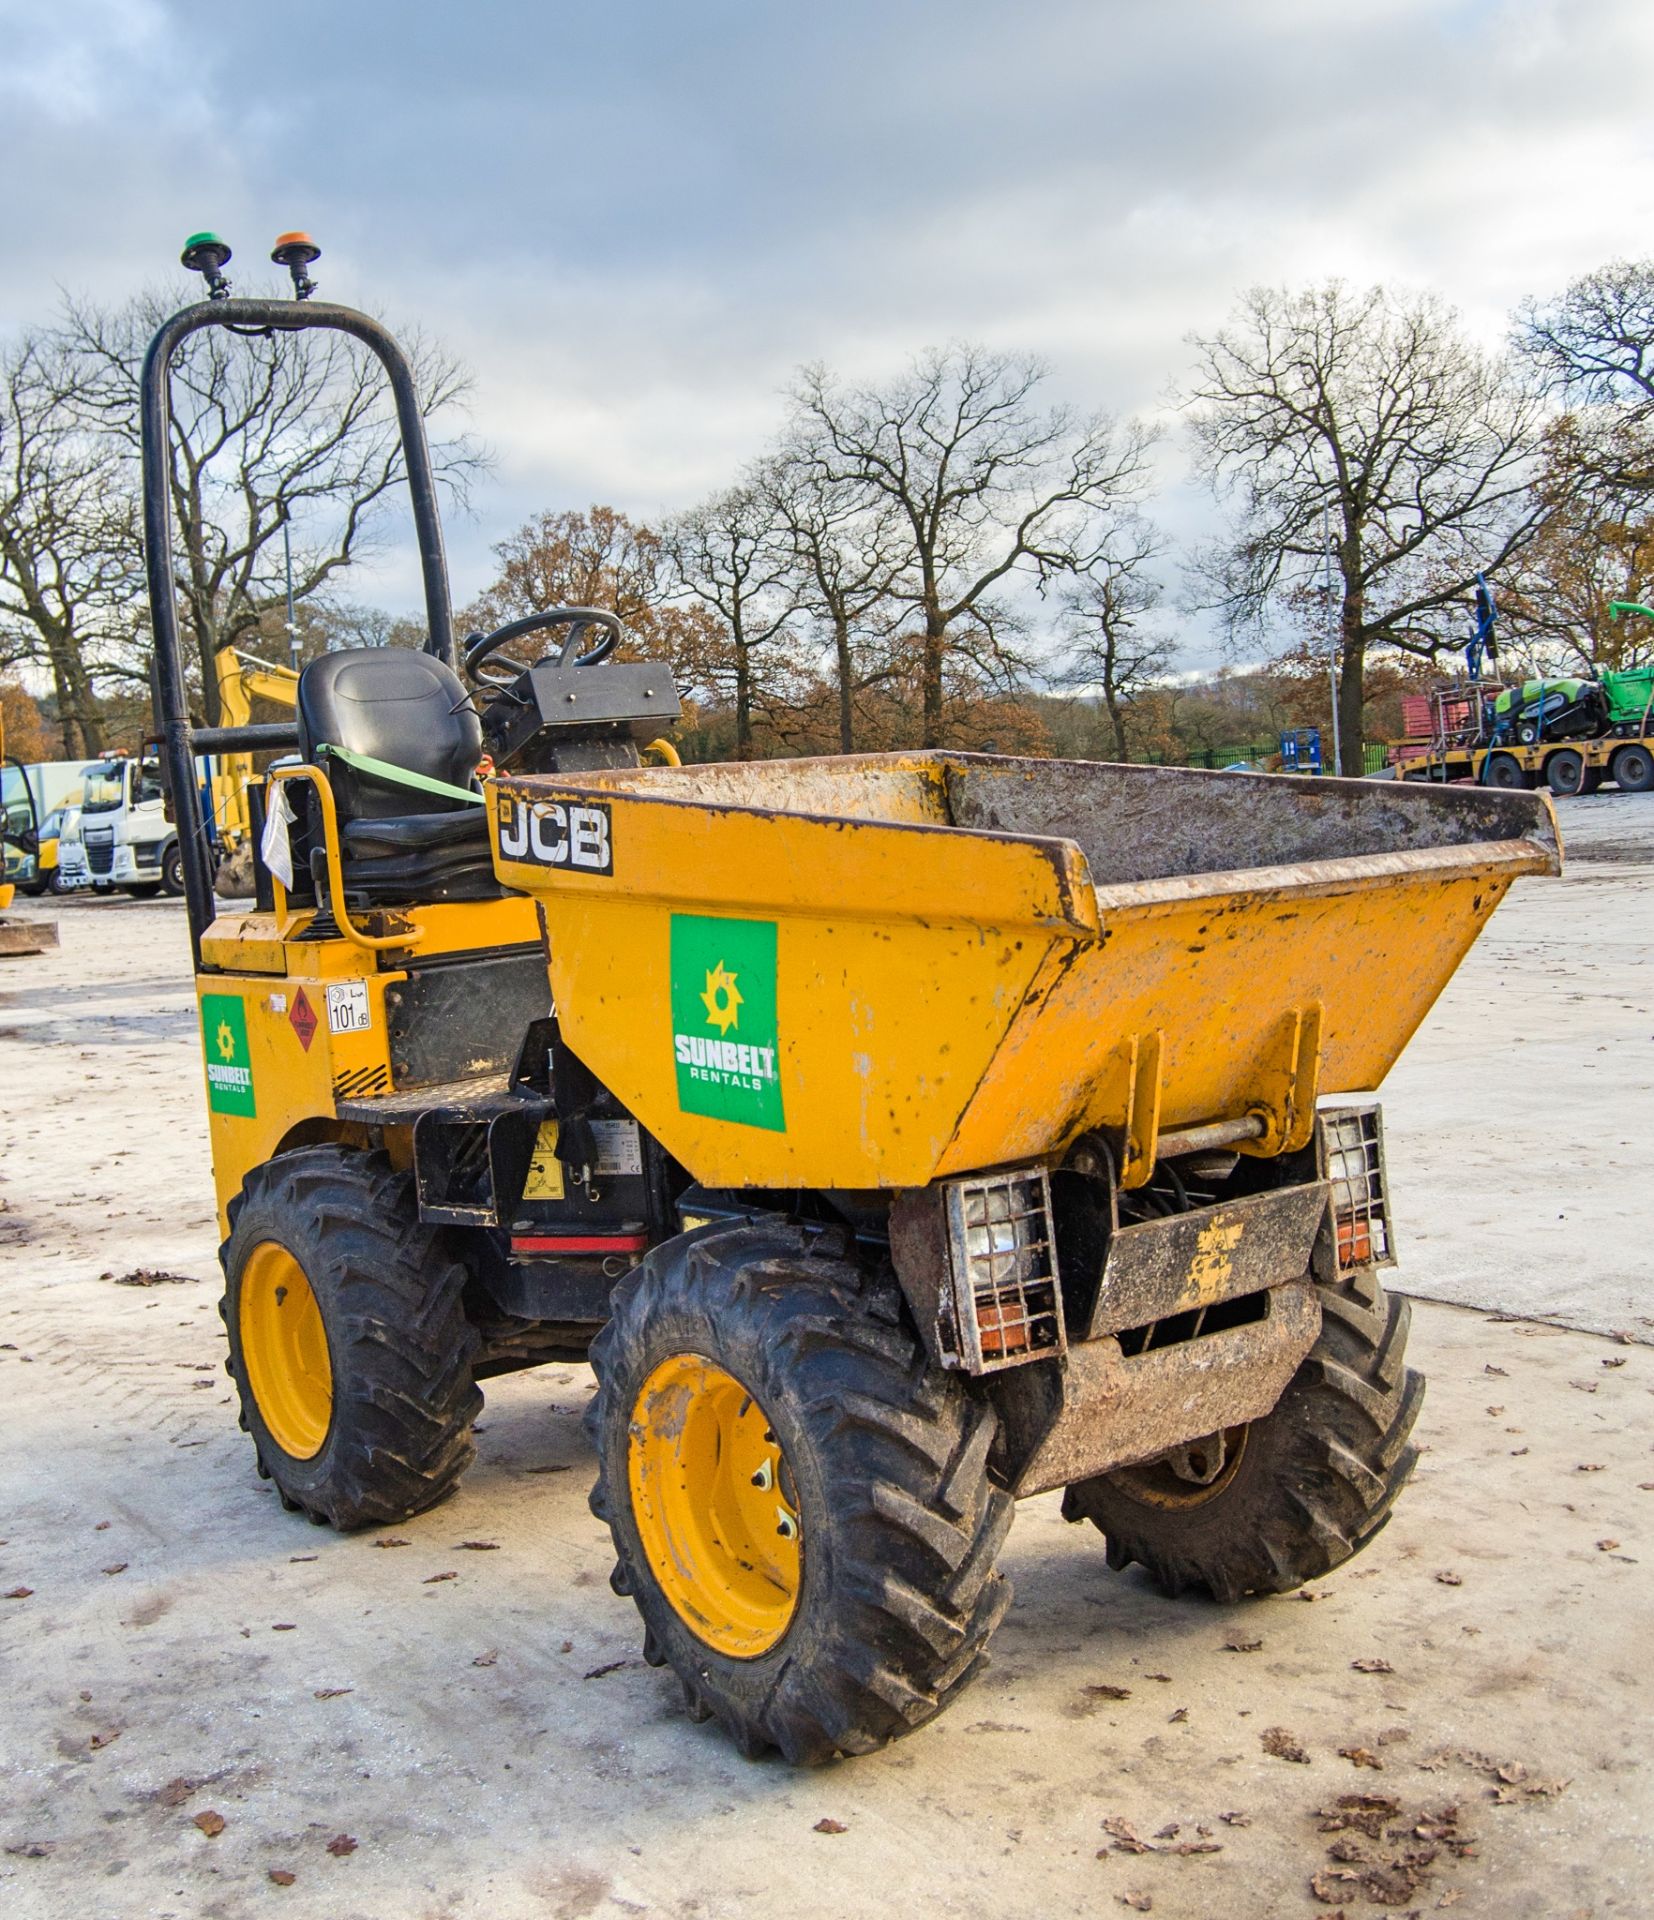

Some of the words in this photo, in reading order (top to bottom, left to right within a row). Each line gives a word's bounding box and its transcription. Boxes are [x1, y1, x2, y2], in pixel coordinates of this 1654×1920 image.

[501, 801, 610, 869] JCB
[333, 1003, 355, 1029] 101
[358, 1013, 368, 1026] dB
[675, 1034, 775, 1079] SUNBELT
[207, 1063, 251, 1087] SUNBELT
[214, 1082, 246, 1093] RENTALS
[690, 1067, 762, 1091] RENTALS
